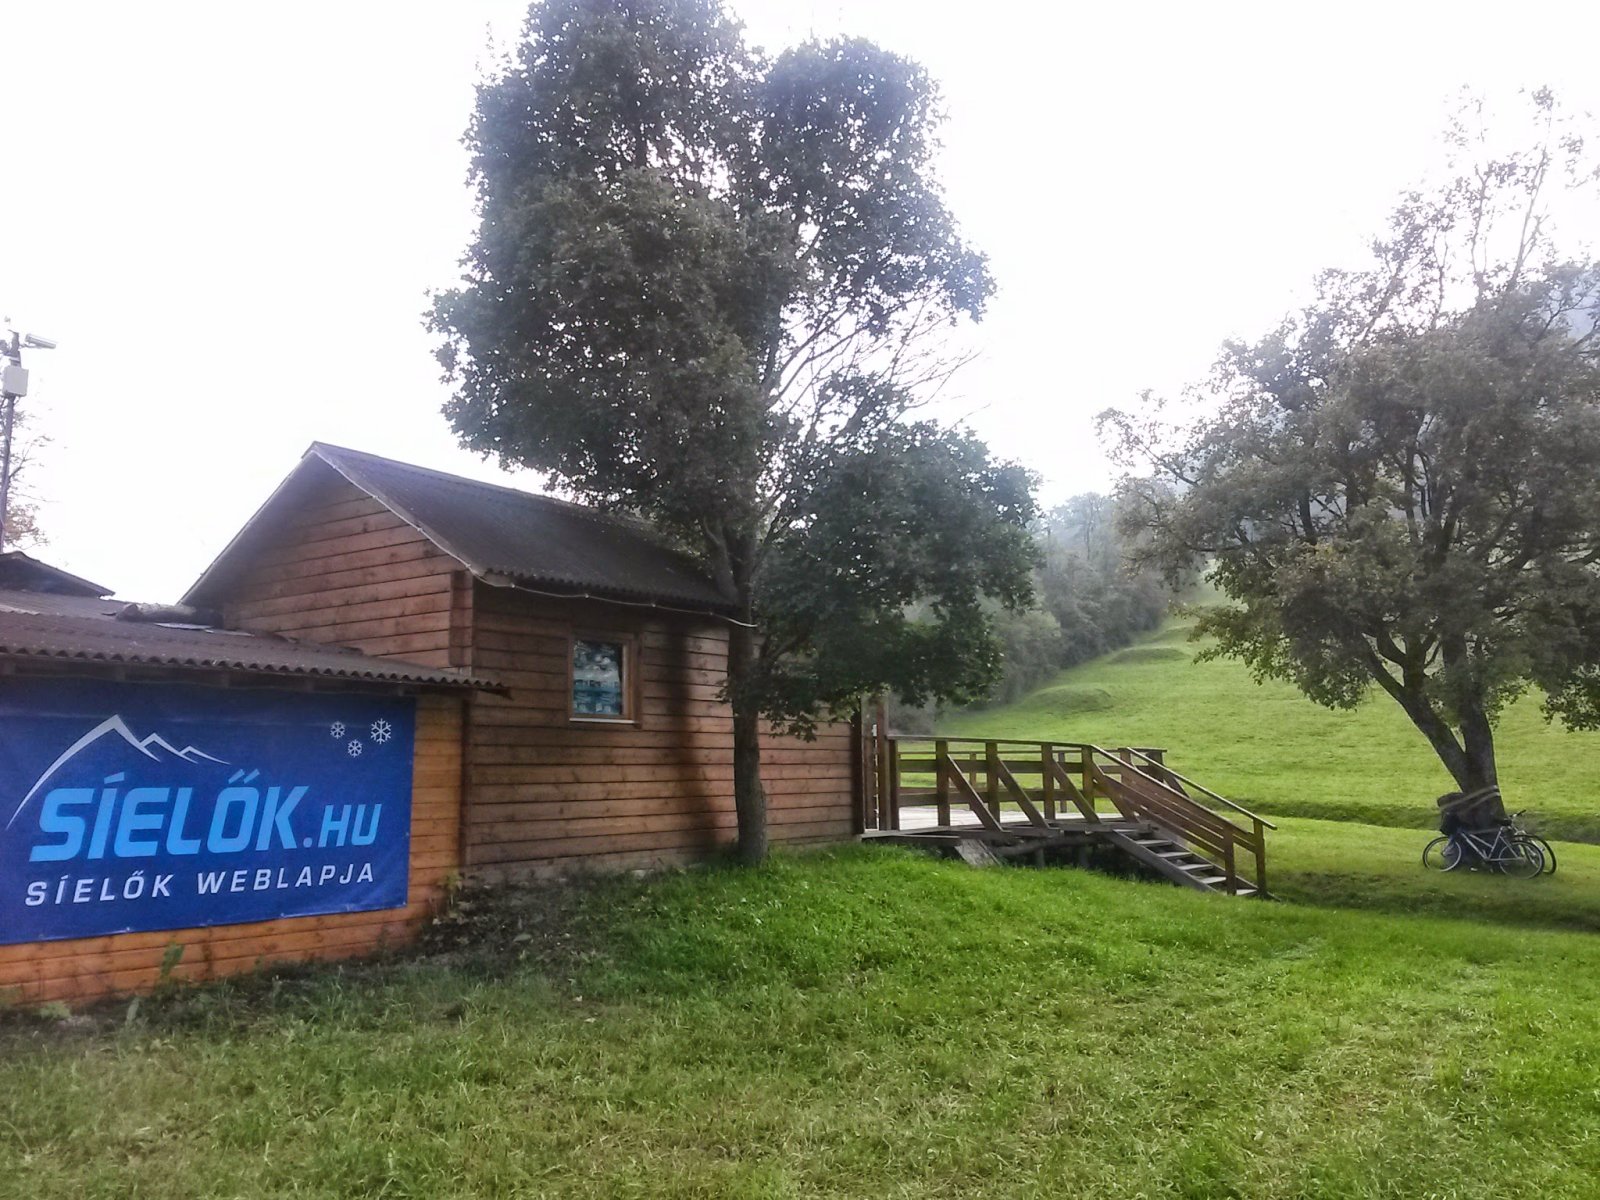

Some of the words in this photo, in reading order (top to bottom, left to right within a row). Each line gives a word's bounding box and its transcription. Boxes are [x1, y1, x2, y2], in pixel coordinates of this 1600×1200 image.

[29, 769, 382, 862] SÍELŐK.HU
[25, 870, 174, 906] SÍELŐK
[197, 862, 374, 895] WEBLAPJA
